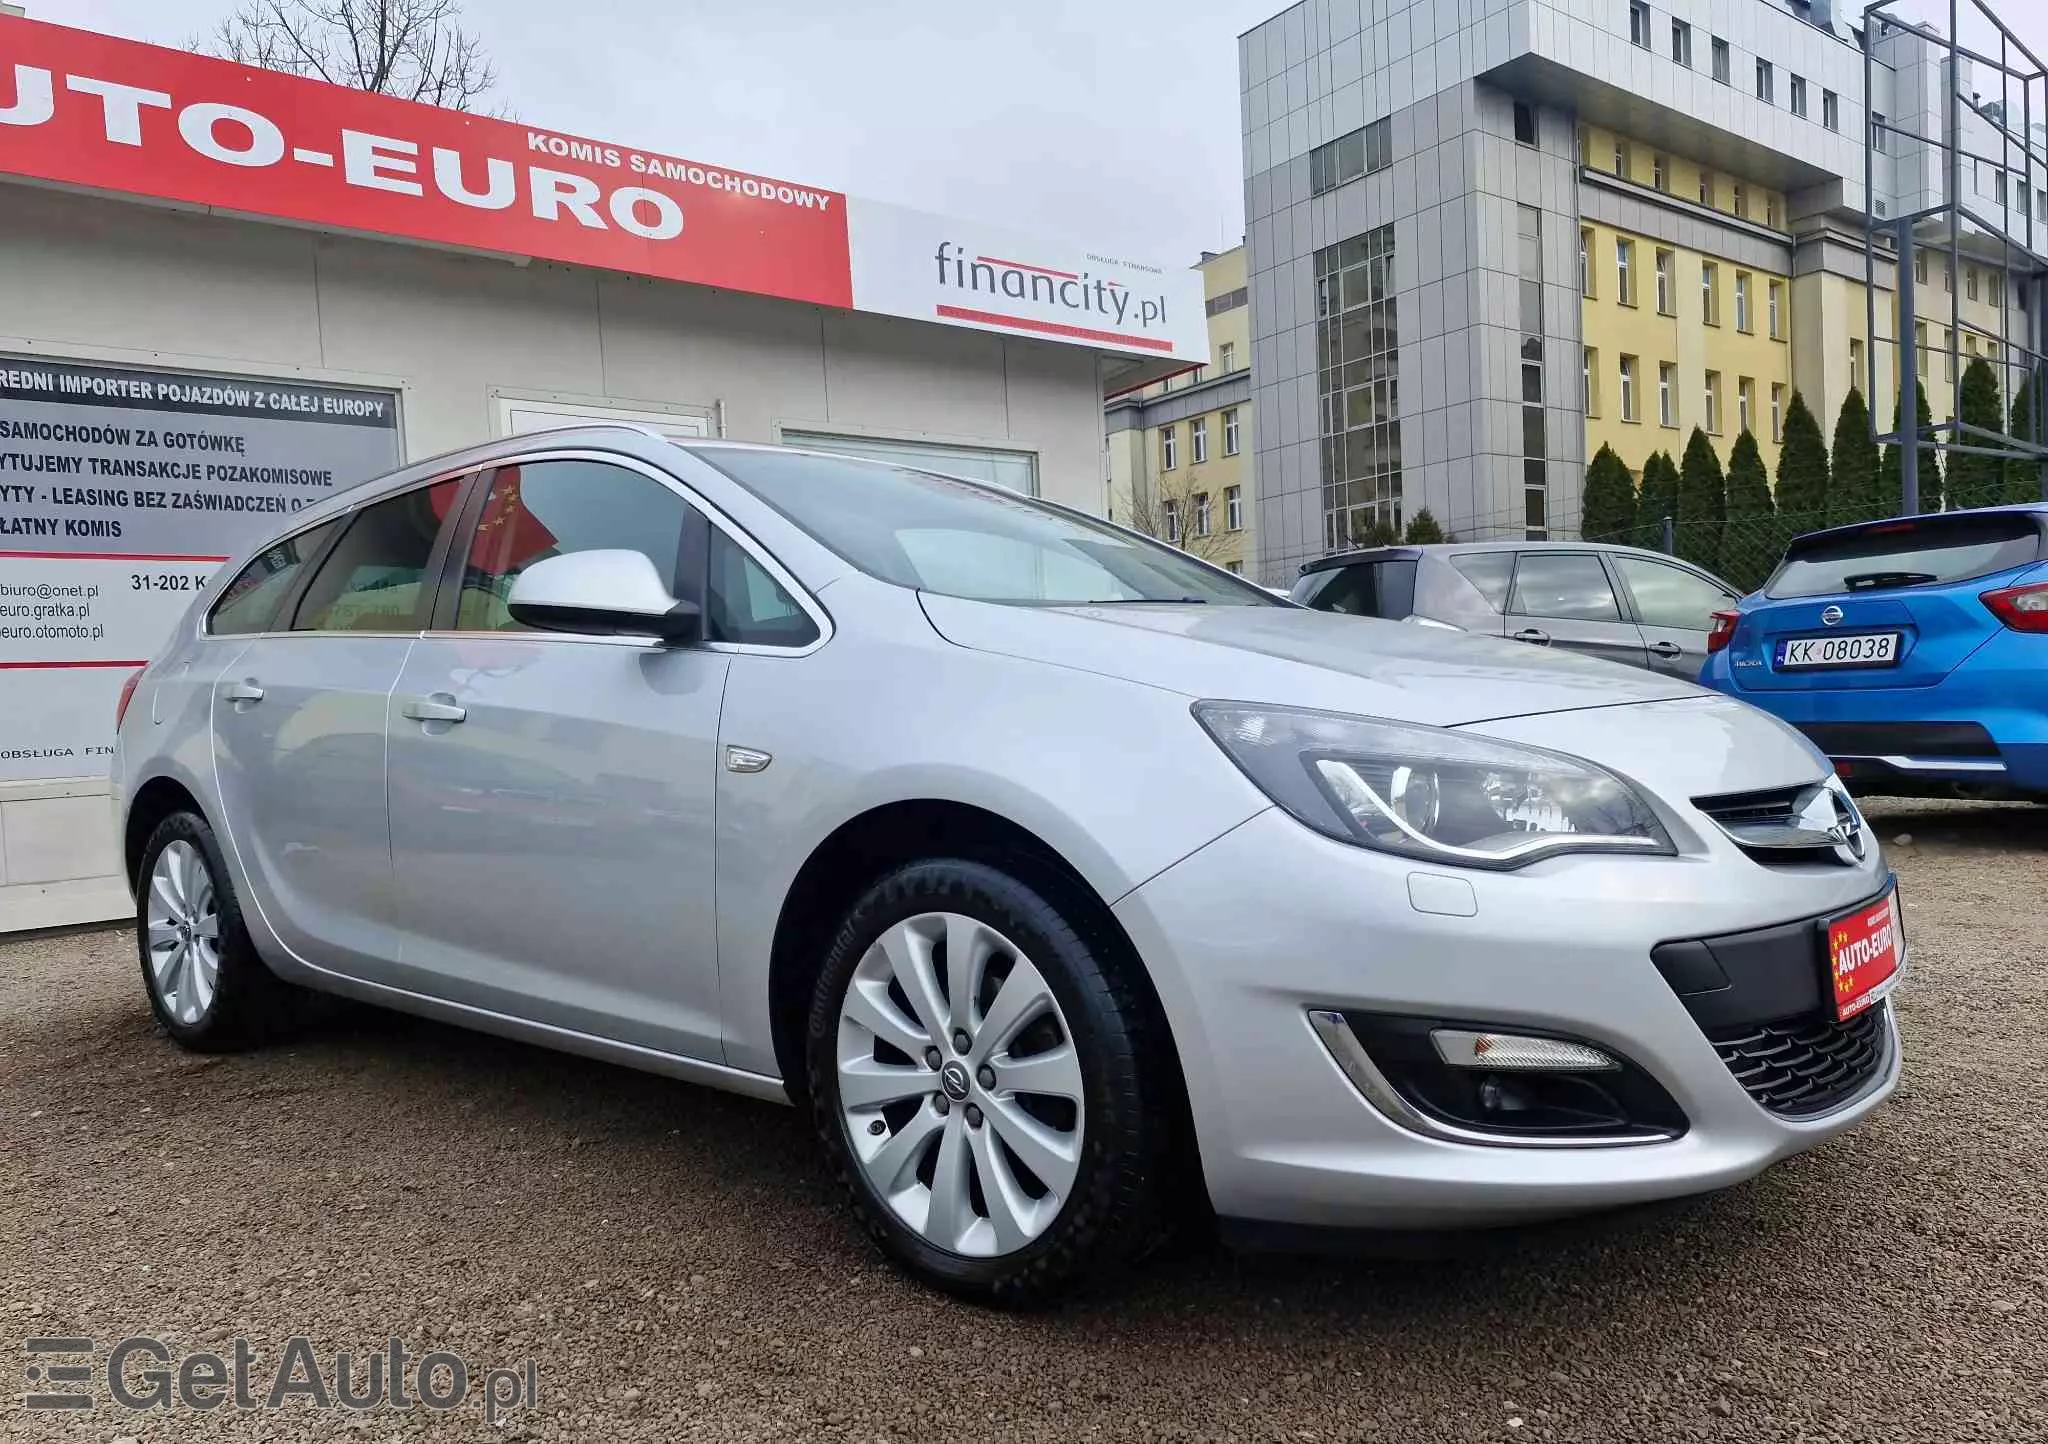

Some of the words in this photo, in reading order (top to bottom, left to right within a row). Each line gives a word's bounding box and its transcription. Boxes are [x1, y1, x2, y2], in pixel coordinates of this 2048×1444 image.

[527, 131, 621, 168] KOMIS
[629, 154, 829, 210] SAMOCHODOWY
[935, 241, 1167, 327] financity.pl
[0, 370, 54, 391] REDNI
[59, 374, 153, 400] IMPORTER
[157, 383, 250, 407] POJAZDÓW
[254, 391, 266, 408] Z
[269, 392, 319, 413] CAŁEJ
[323, 398, 384, 418] EUROPY
[0, 419, 130, 446] SAMOCHODÓW
[135, 429, 159, 448] ZA
[163, 430, 246, 457] GOTÓWKĘ
[88, 457, 201, 480] TRANSAKCJE
[206, 464, 333, 487] POZAKOMISOWE
[0, 484, 35, 503] YTY
[52, 487, 129, 508] LEASING
[134, 490, 167, 509] BEZ
[171, 490, 287, 513] ZAŚWIADCZEŃ
[64, 519, 122, 538] KOMIS
[0, 583, 99, 599] biuro@onet.pl
[131, 574, 190, 591] 31-202
[0, 602, 90, 621] euro.gratka.pl
[1789, 642, 1815, 662] KK
[1823, 637, 1889, 661] 08038
[0, 748, 74, 760] OBSŁUGA
[85, 746, 114, 755] FIN
[1839, 924, 1892, 976] AUTO-EURO
